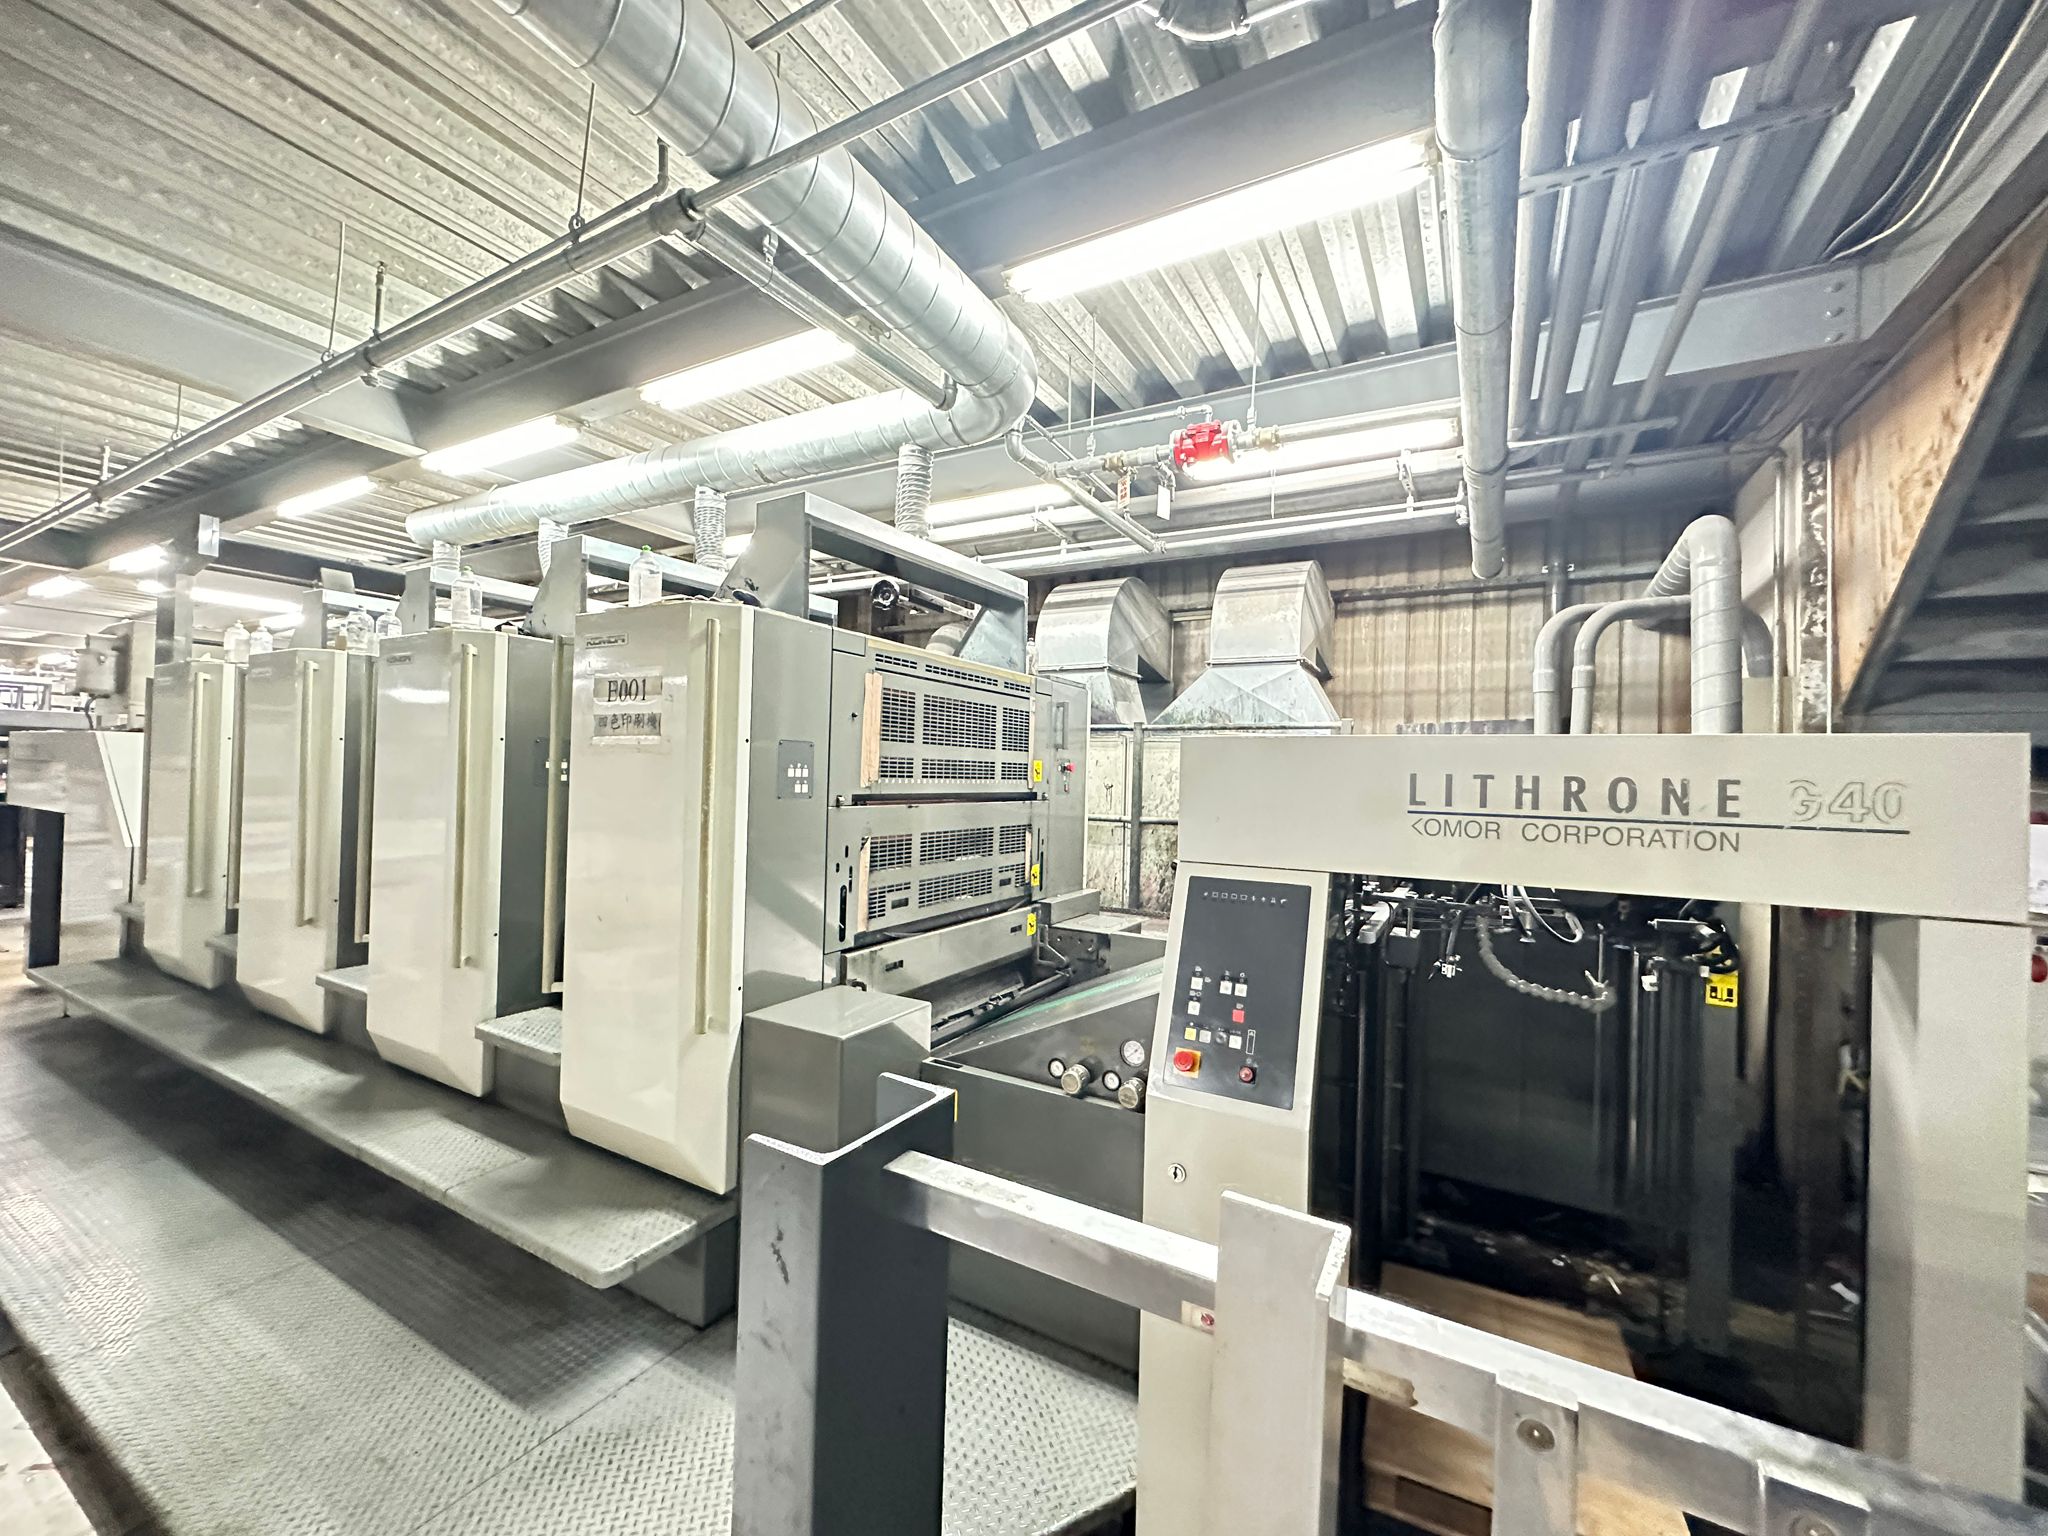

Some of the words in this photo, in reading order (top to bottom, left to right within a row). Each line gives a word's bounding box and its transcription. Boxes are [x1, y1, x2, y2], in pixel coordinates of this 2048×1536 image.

[607, 678, 647, 702] E001
[1409, 773, 1741, 818] LITHRONE
[1521, 822, 1740, 852] CORPORATION
